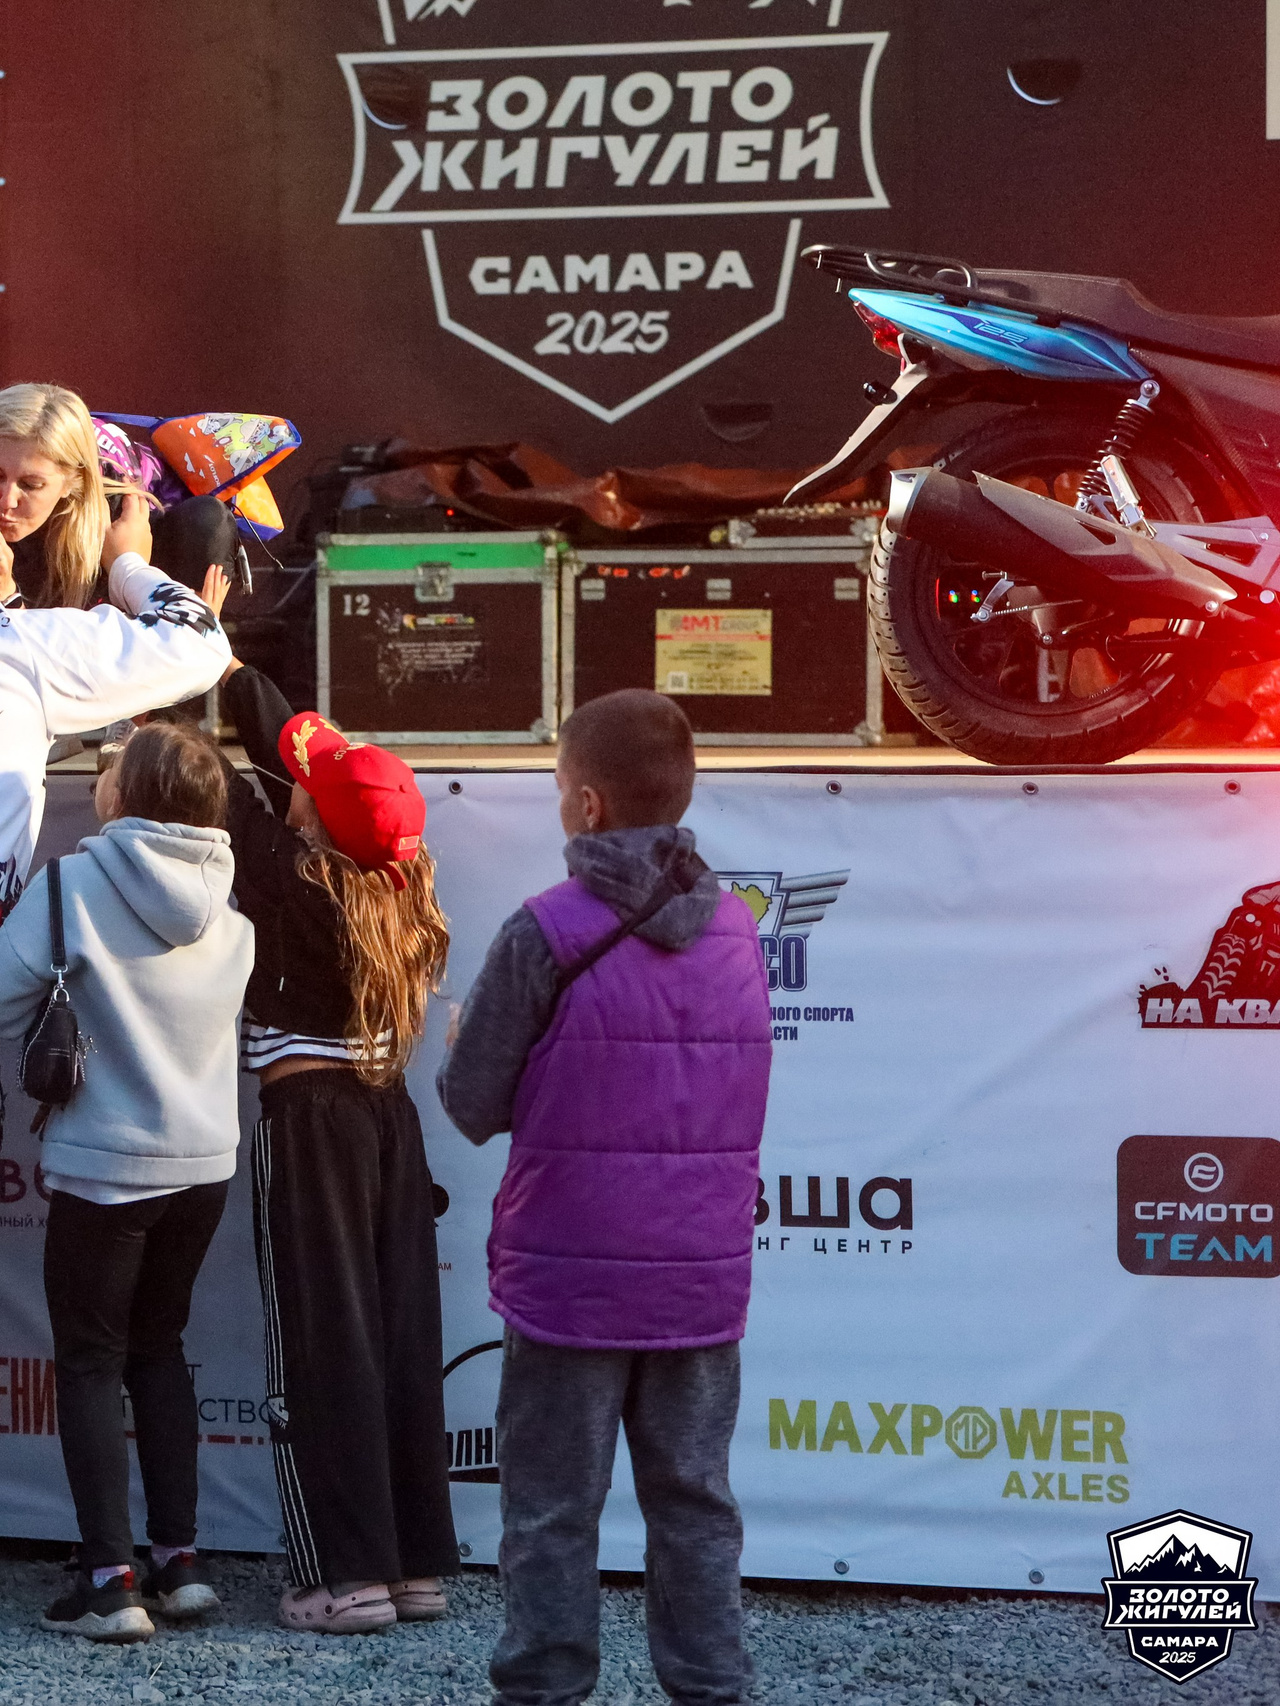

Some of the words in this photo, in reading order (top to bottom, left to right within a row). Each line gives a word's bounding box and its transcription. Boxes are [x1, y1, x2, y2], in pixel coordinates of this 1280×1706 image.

[426, 67, 793, 131] ЗОЛОТО
[370, 113, 839, 211] ЖИГУЛЕЙ
[469, 250, 753, 295] САМАРА
[534, 310, 669, 354] 2025
[973, 322, 1028, 343] 125
[343, 594, 370, 616] 12
[803, 1007, 854, 1022] СПОРТА
[1145, 998, 1203, 1023] НА
[771, 1026, 798, 1041] СТИ
[1135, 1202, 1274, 1222] CFMOTO
[814, 1238, 913, 1254] ЦЕНТР
[1135, 1233, 1273, 1262] TEAM
[1001, 1471, 1130, 1504] AXLES
